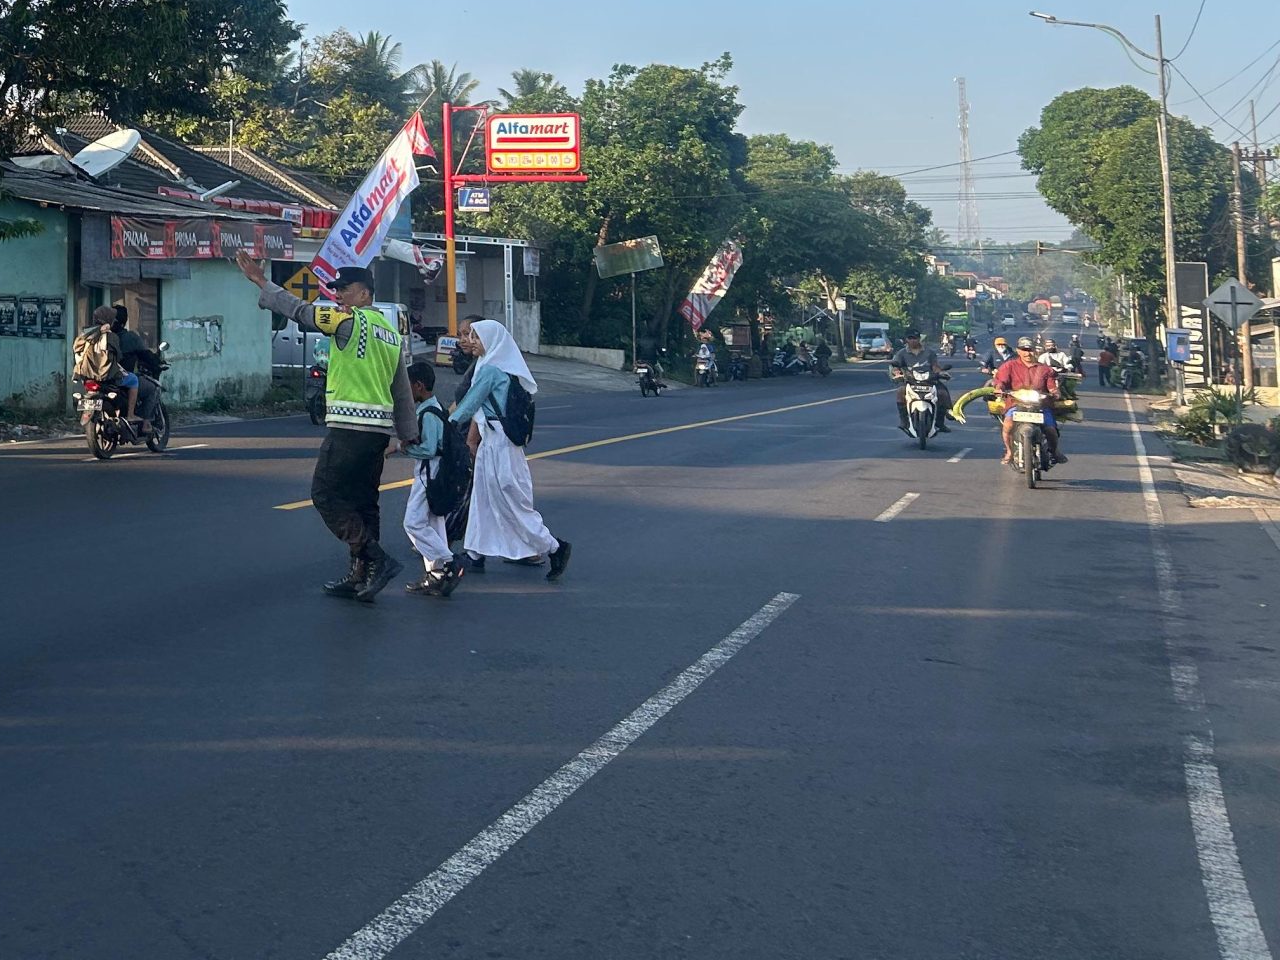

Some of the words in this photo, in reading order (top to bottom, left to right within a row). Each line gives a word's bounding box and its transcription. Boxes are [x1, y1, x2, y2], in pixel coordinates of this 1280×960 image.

[497, 122, 569, 134] Alfamart
[340, 157, 400, 248] Alfamart
[123, 230, 149, 247] PRIMA
[175, 231, 197, 247] PRIMA
[220, 232, 242, 248] PRIMA
[263, 234, 284, 250] PRIMA
[1180, 305, 1205, 384] VICTORY
